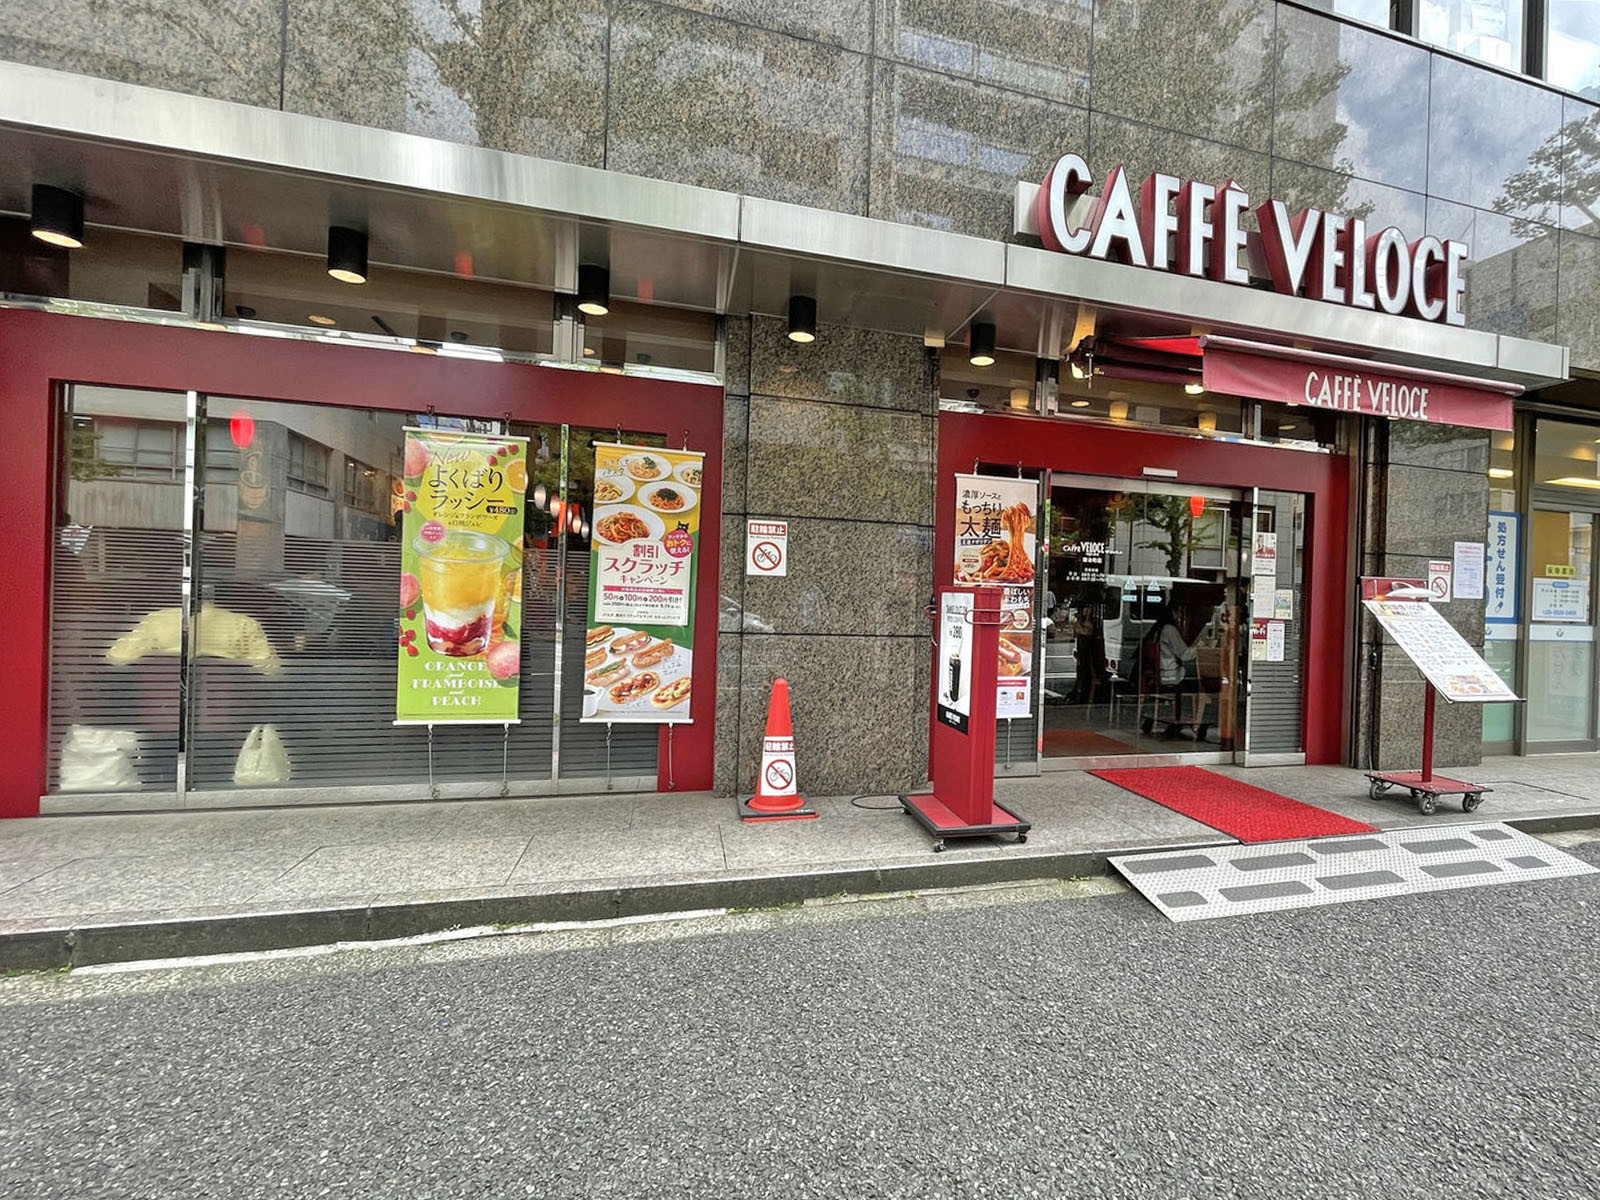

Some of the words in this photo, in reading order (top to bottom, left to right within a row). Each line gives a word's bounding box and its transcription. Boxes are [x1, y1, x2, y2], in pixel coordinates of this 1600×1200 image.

[1038, 152, 1250, 286] CAFFÈ
[1256, 198, 1468, 327] VELOCE
[1304, 370, 1362, 412] CAFFÈ
[1367, 380, 1430, 420] VELOCE
[428, 464, 503, 494] よくばり
[430, 489, 505, 511] ラッシー
[961, 489, 1001, 500] 濃厚ソースと
[961, 500, 1002, 516] もっちり
[960, 516, 1001, 539] 太麺
[633, 543, 659, 558] 割引
[1080, 541, 1104, 554] VELOCE
[603, 557, 685, 577] スクラッチ
[1496, 522, 1507, 599] 処方せん受付
[620, 574, 668, 585] キャンペーン
[431, 695, 482, 706] PEACH
